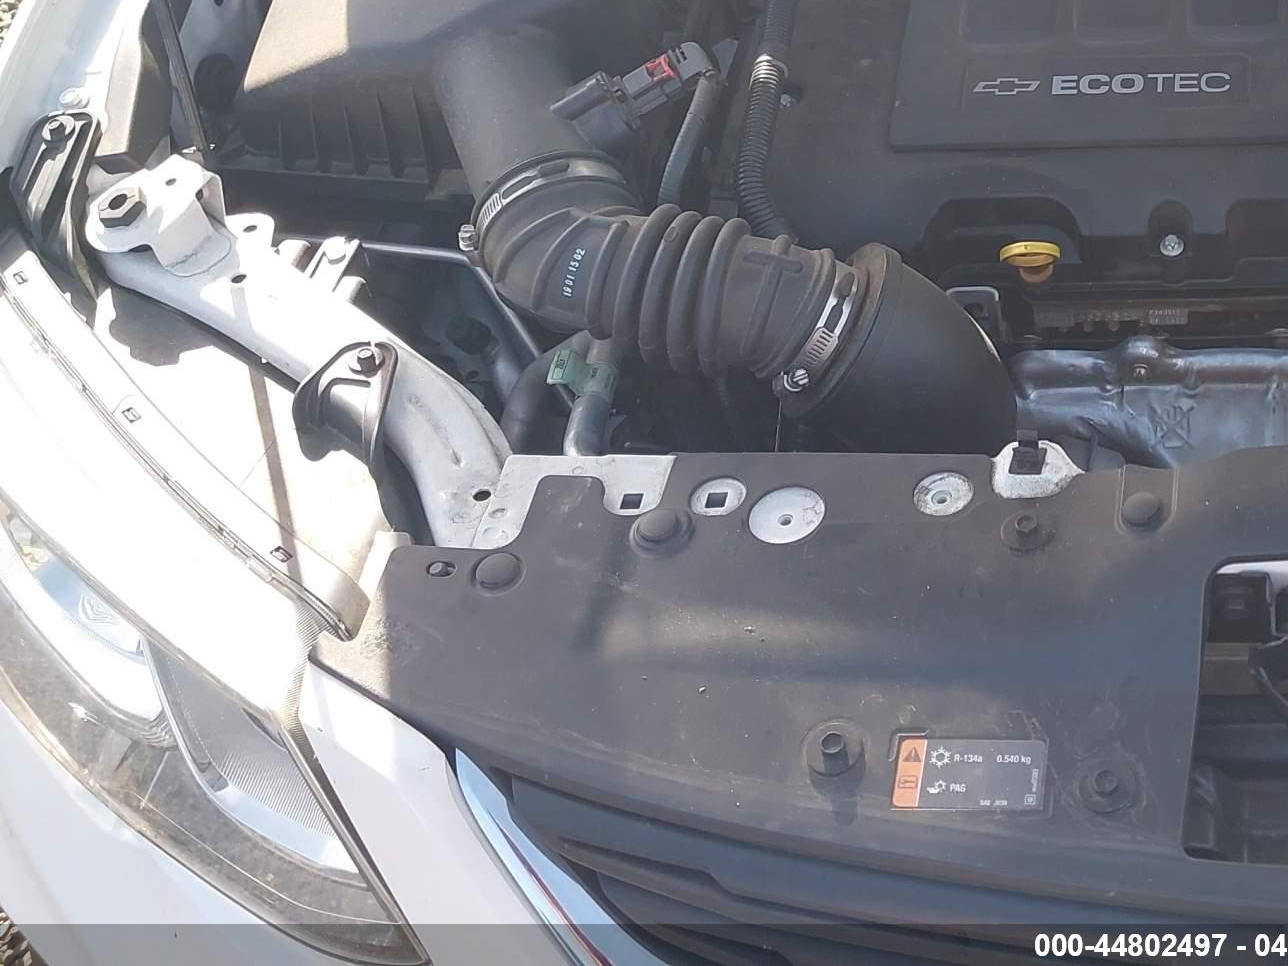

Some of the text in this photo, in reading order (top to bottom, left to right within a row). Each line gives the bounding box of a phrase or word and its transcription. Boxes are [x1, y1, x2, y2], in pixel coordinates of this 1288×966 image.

[1051, 71, 1231, 96] ECOTEC
[953, 753, 1032, 765] R-134a 0.540 kg
[949, 783, 967, 793] PAG
